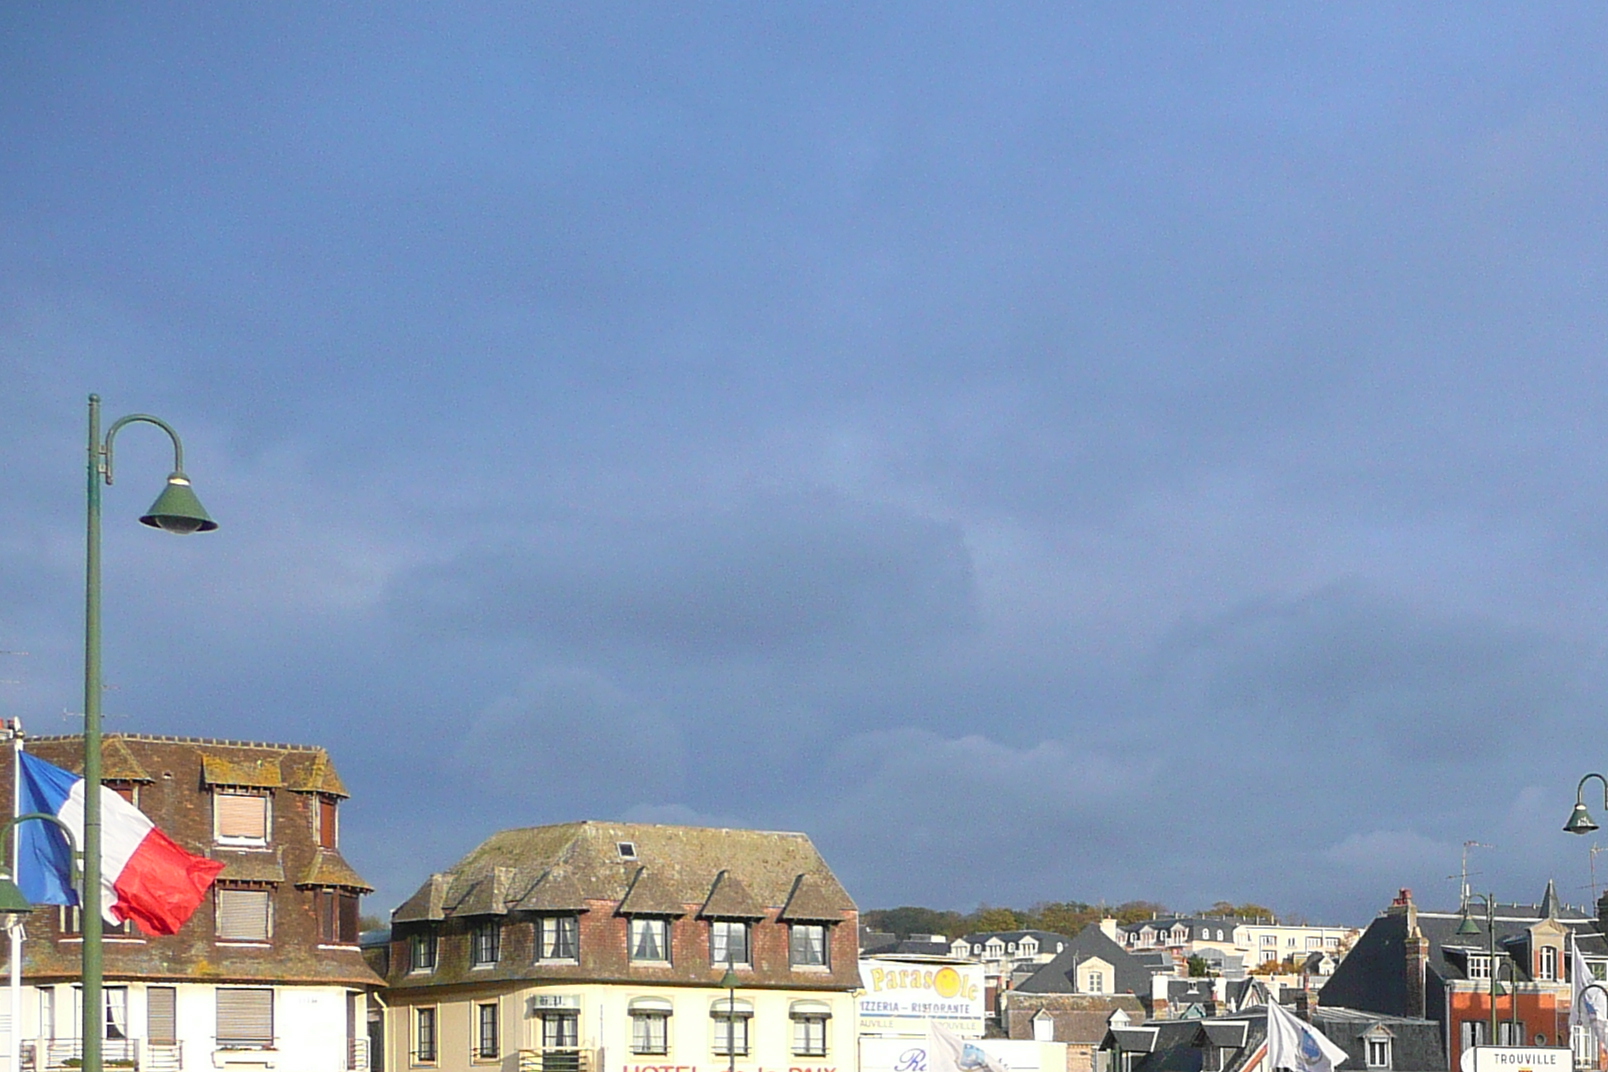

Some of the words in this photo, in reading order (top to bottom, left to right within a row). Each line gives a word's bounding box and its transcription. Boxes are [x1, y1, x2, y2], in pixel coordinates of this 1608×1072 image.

[860, 1001, 899, 1012] IZZERIA
[911, 1002, 970, 1014] RISTORANTE
[1494, 1053, 1557, 1065] TROUVILLE
